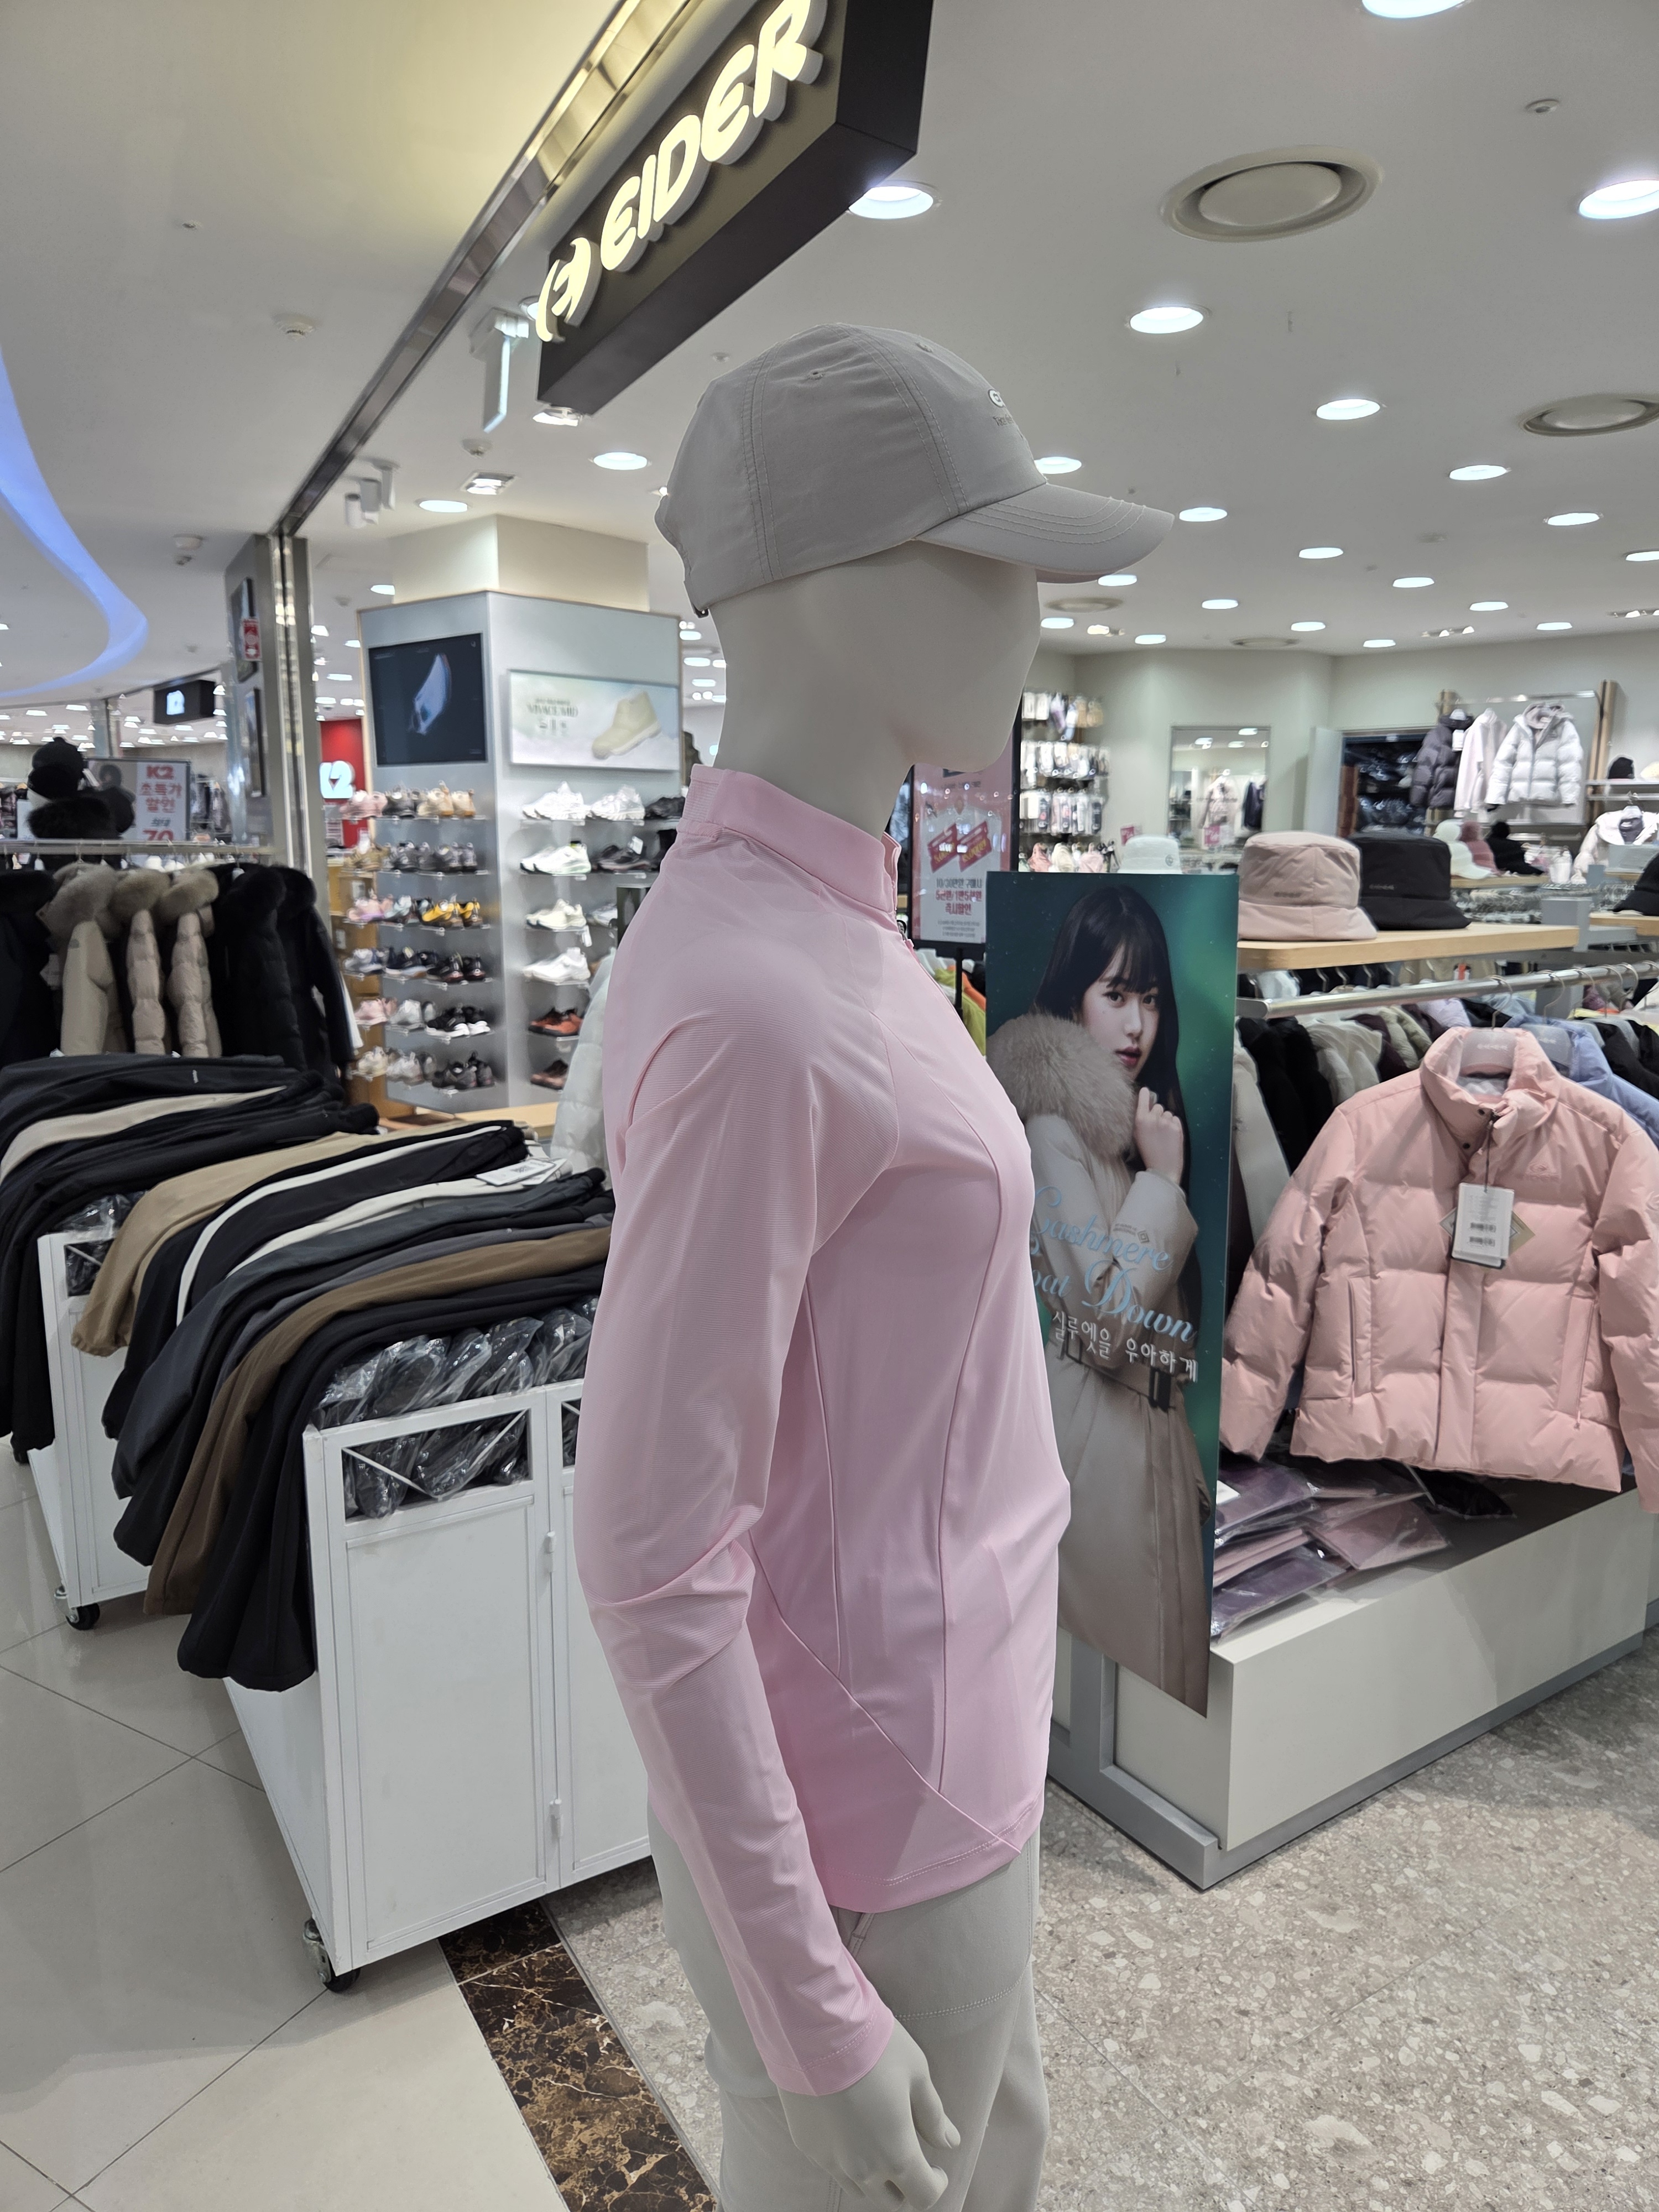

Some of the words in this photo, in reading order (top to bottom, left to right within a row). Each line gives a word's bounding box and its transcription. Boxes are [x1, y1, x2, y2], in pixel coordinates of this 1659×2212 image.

[601, 0, 814, 271] EIDER
[146, 765, 174, 780] K2
[1081, 1259, 1198, 1344] Down
[1052, 1310, 1112, 1360] 실루엣을
[1124, 1337, 1199, 1383] 우아하게
